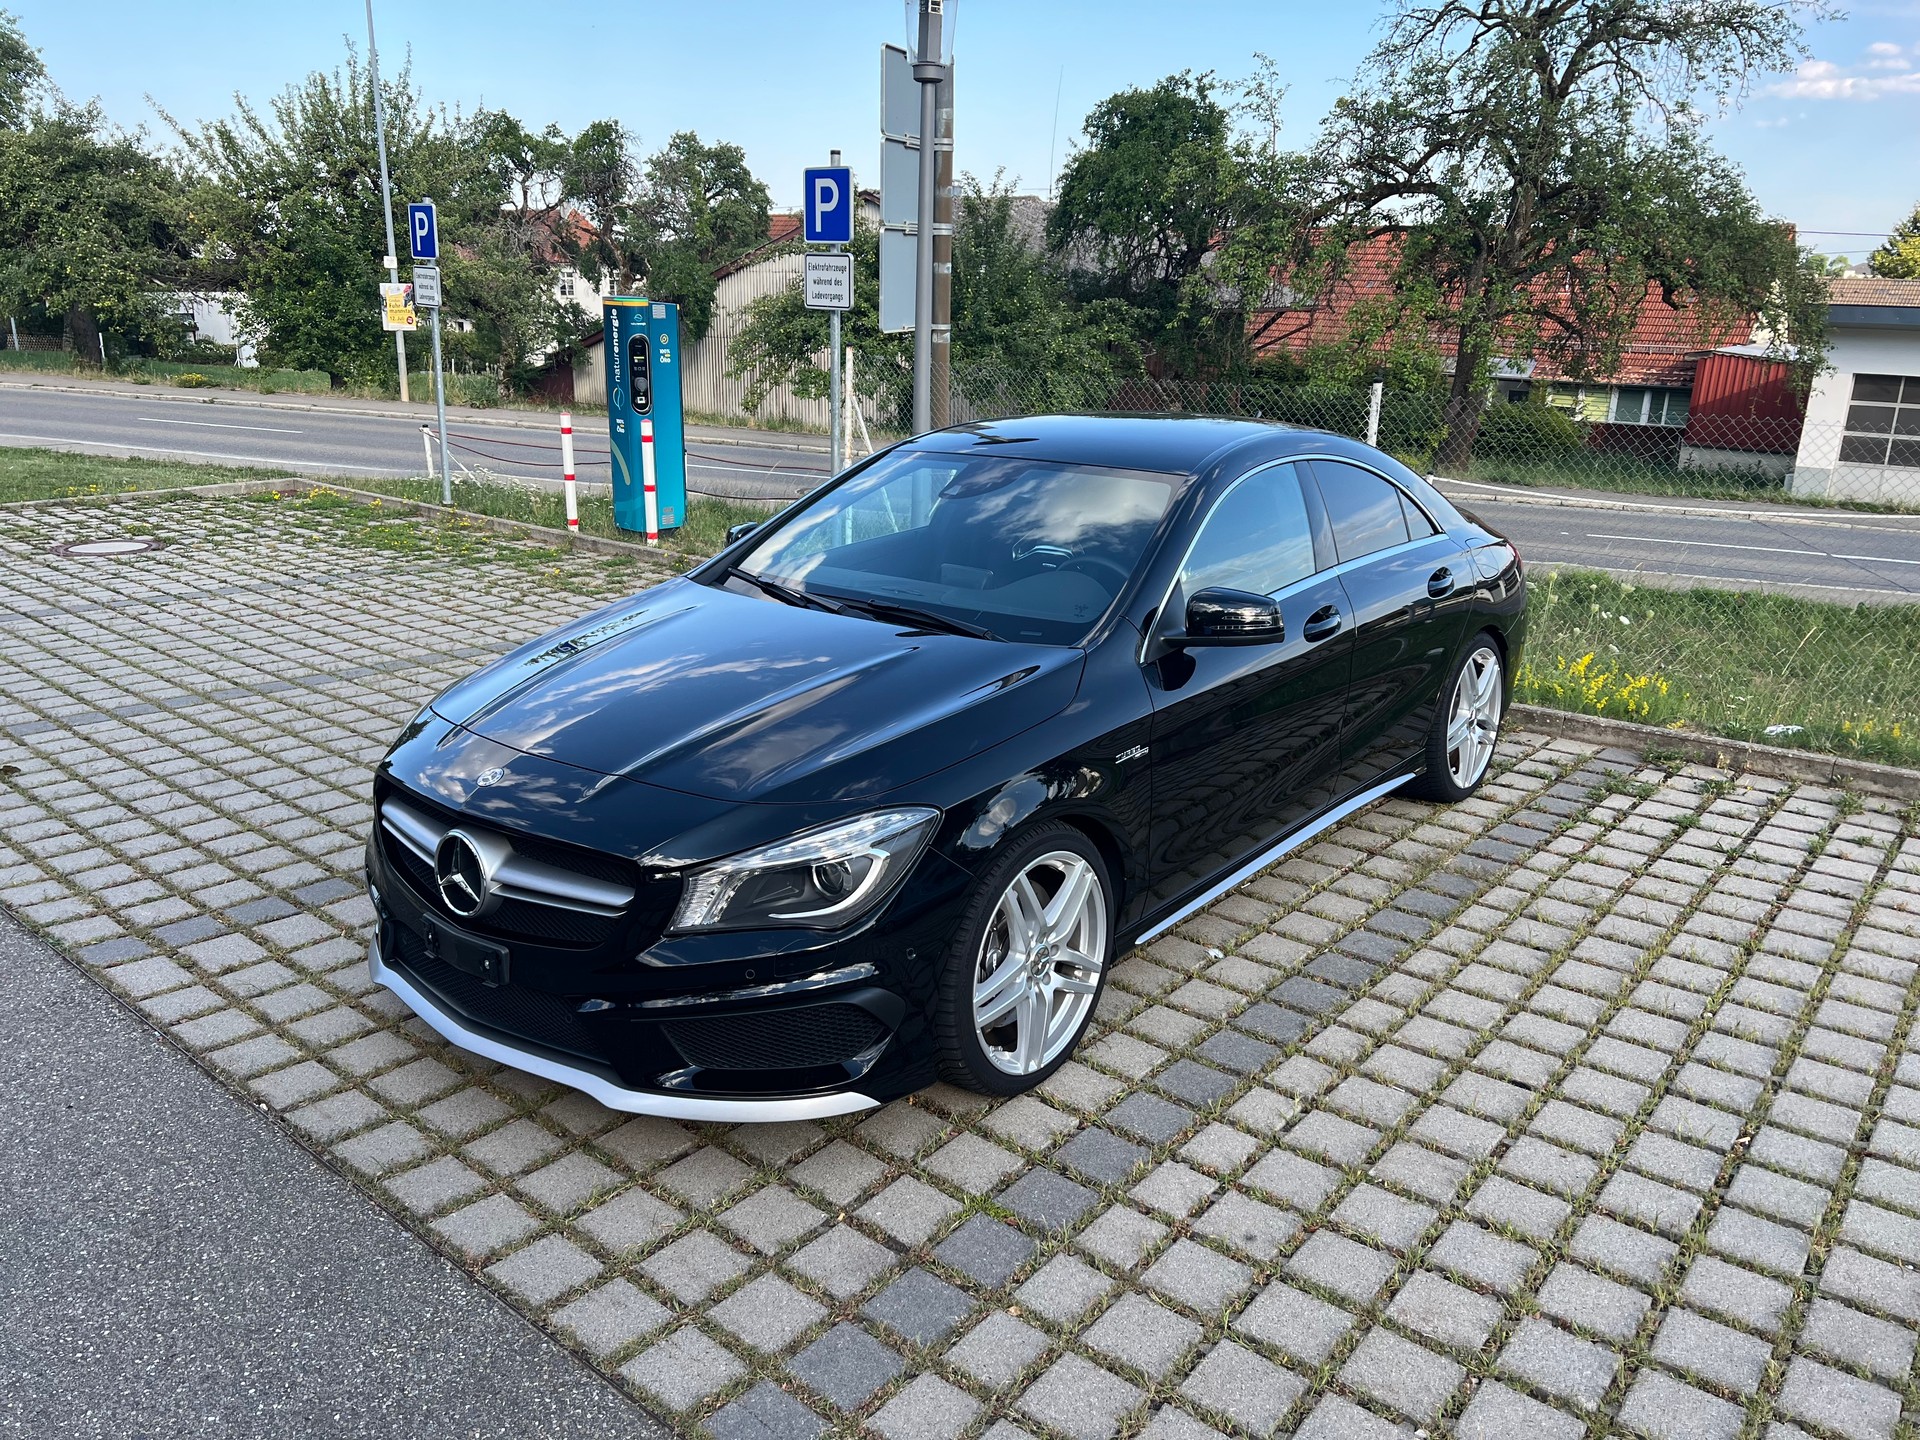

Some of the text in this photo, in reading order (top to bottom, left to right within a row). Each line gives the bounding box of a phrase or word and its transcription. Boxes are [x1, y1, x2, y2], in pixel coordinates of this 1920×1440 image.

[815, 178, 839, 232] P
[414, 212, 428, 251] P
[808, 262, 847, 274] Elektrofahrzeuge
[813, 277, 842, 287] während des
[811, 291, 844, 302] Ladevorgangs
[610, 308, 621, 382] naturenergie
